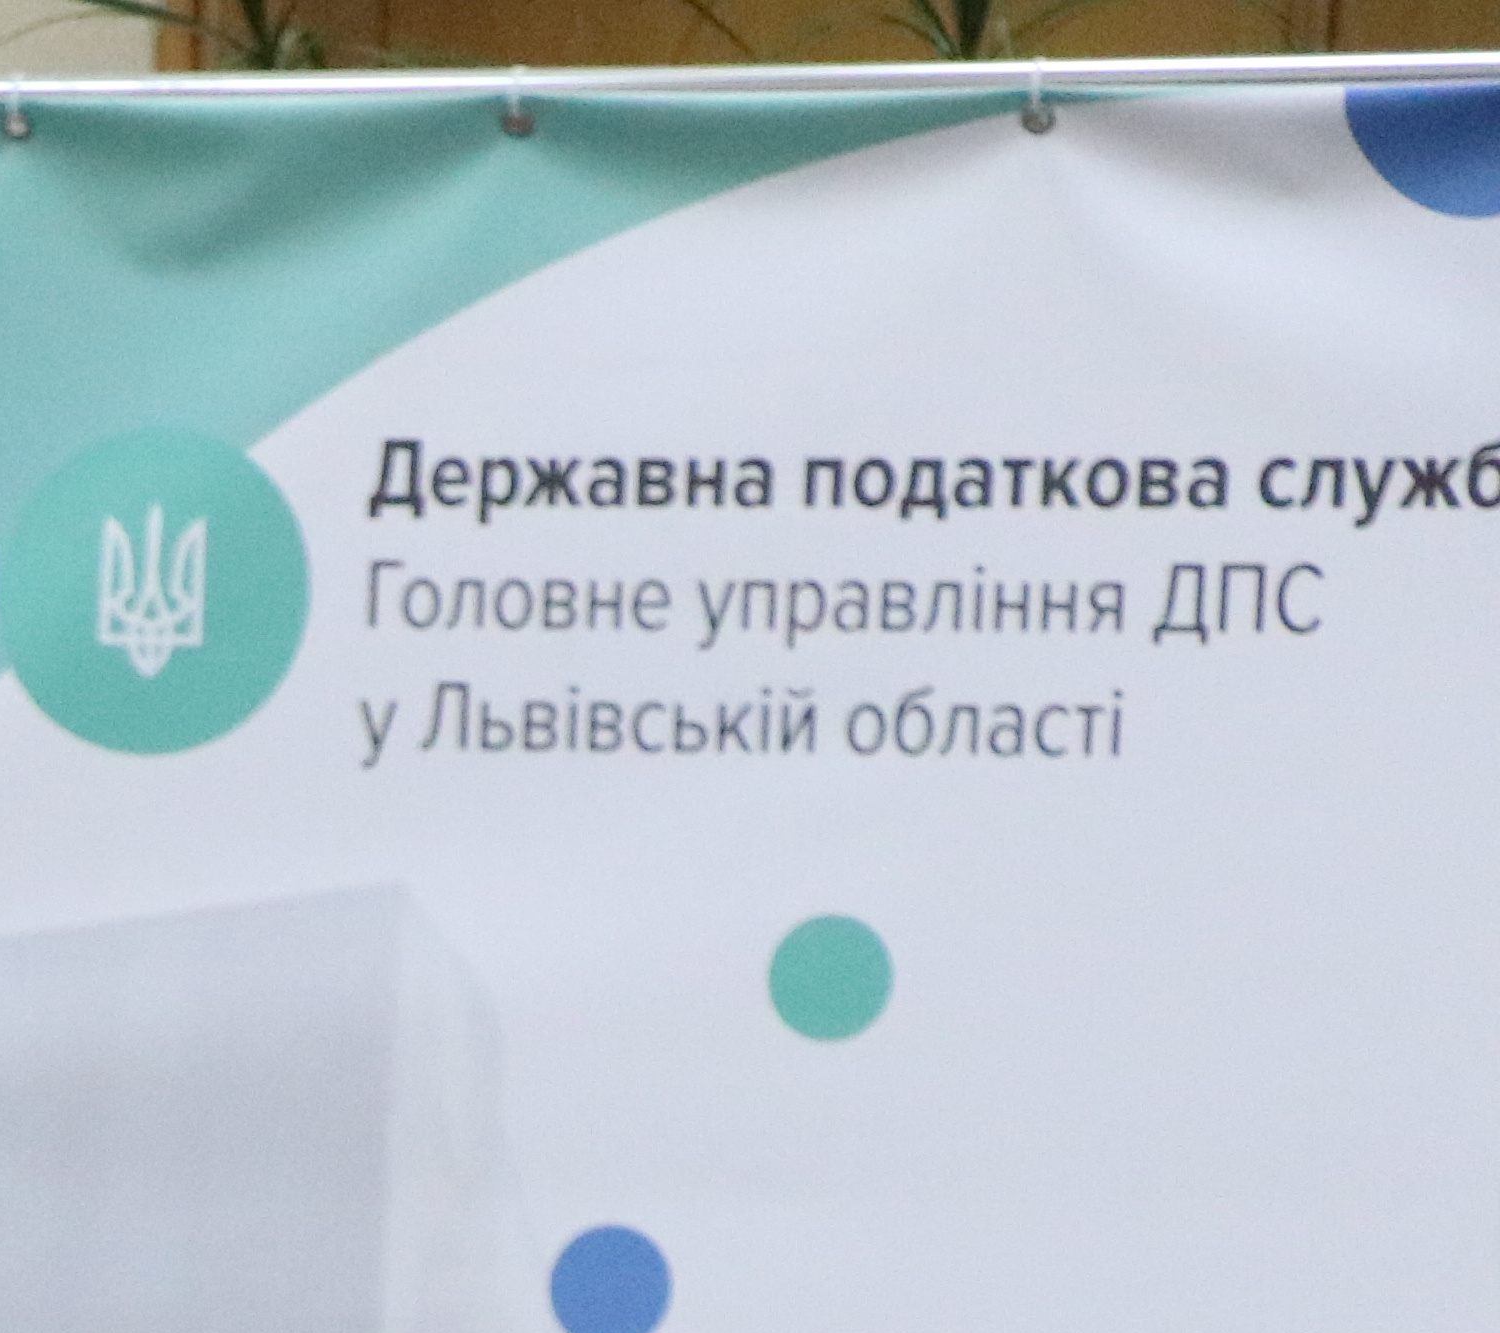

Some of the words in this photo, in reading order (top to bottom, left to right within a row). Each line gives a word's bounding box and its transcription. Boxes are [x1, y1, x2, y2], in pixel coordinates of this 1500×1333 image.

[364, 436, 775, 525] Державна
[801, 455, 1230, 521] податкова
[365, 558, 672, 632] Головне
[696, 565, 1125, 650] управління
[1150, 561, 1324, 646] ДПС
[357, 699, 398, 770] у
[419, 680, 817, 754] Львівській
[844, 686, 1123, 759] області
